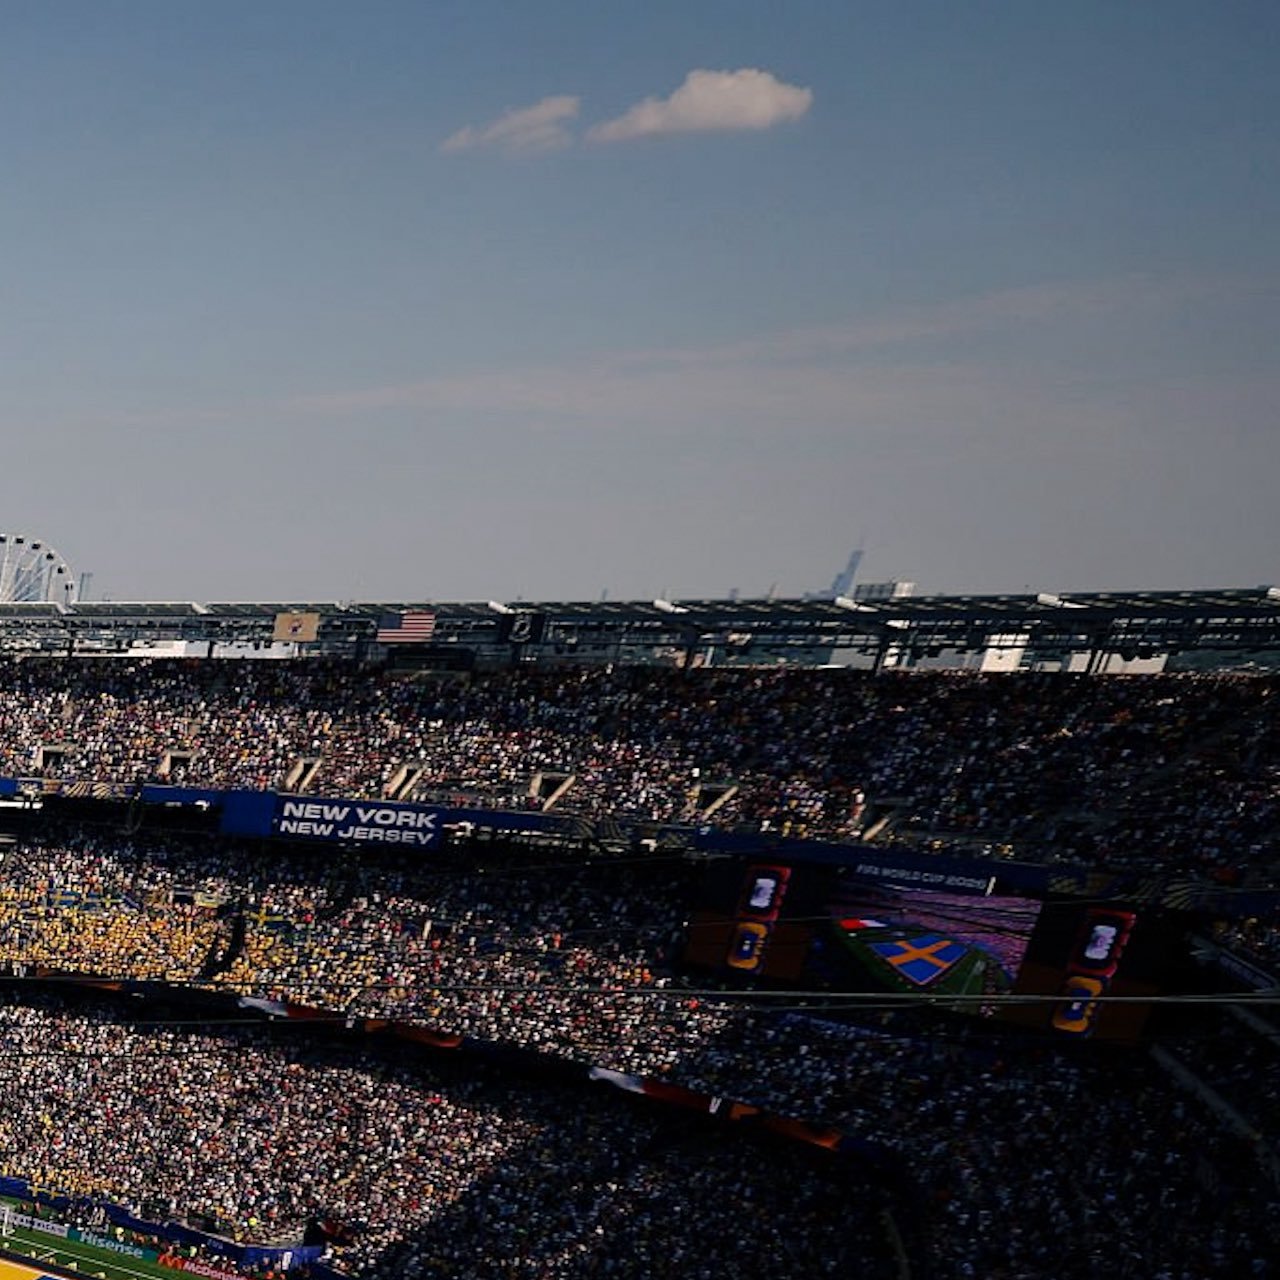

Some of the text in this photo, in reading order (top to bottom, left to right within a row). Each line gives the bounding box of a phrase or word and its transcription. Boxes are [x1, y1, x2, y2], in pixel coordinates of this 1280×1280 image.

[282, 802, 438, 829] NEW YORK
[279, 820, 434, 845] NEW JERSEY
[881, 868, 921, 880] WORLD
[921, 872, 945, 882] CUP
[80, 1230, 144, 1258] Hisense
